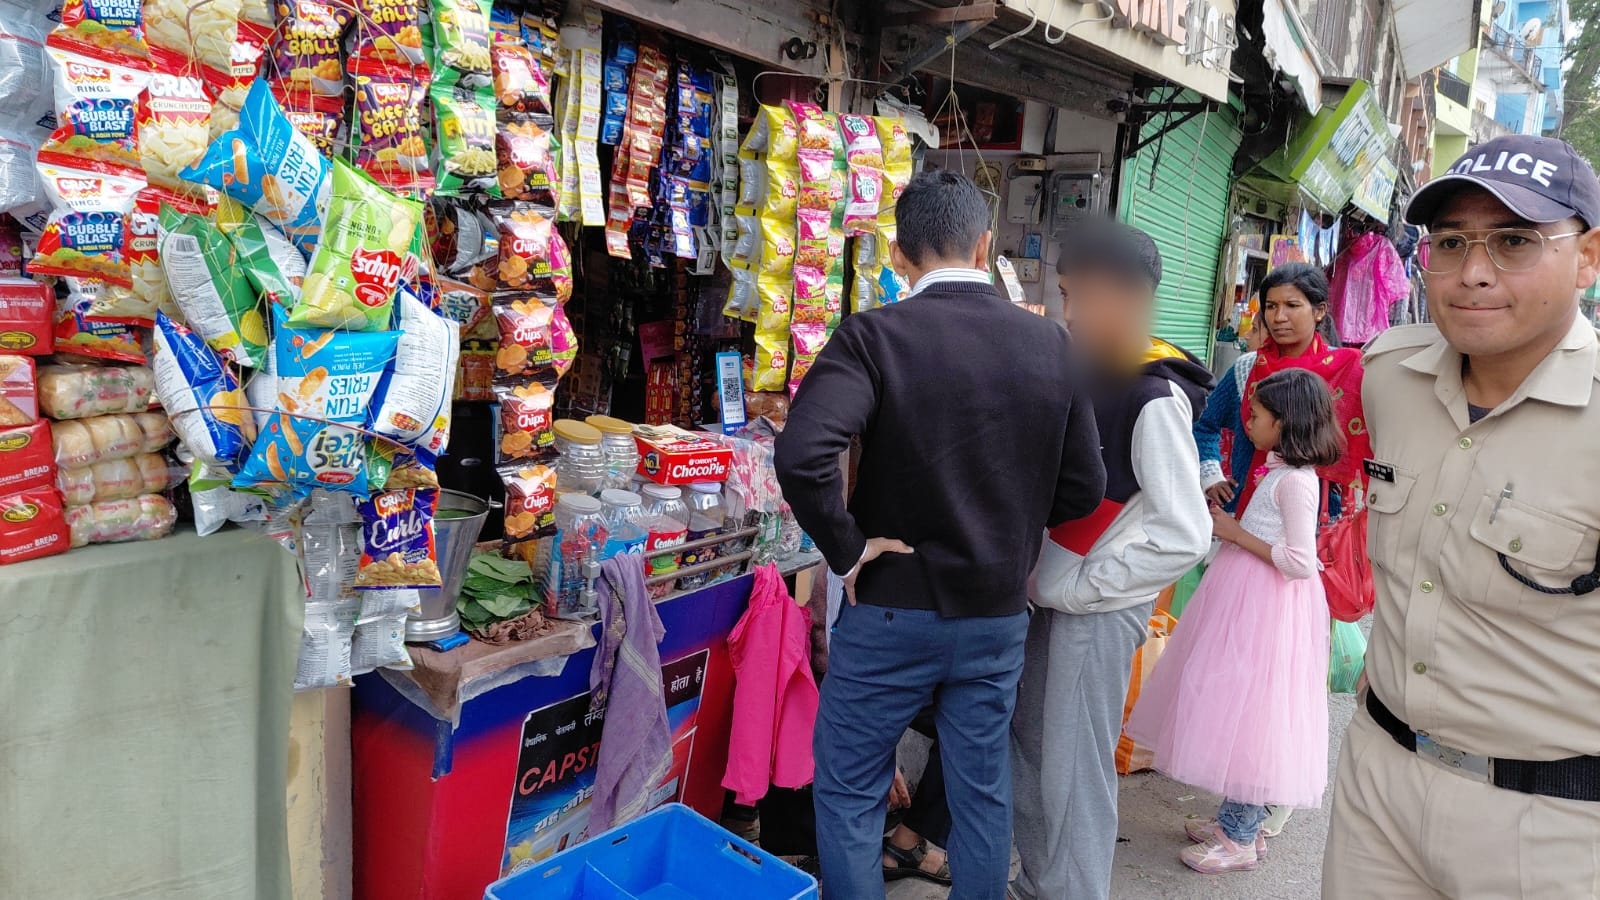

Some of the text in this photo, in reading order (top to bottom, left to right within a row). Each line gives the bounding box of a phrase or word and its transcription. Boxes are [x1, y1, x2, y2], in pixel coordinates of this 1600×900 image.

[100, 6, 138, 19] BLAST
[371, 5, 418, 24] BALLS
[289, 39, 339, 55] BALLS
[70, 63, 107, 77] CRAX
[77, 85, 111, 93] RINGS
[148, 73, 210, 102] CRAX
[376, 84, 405, 97] CRAX
[79, 110, 130, 121] BUBBLE
[290, 113, 320, 125] CRAX
[89, 121, 128, 132] BLAST
[280, 140, 306, 185] FRIES
[60, 179, 98, 190] CRAX
[294, 162, 318, 198] FUN
[67, 223, 119, 236] BUBBLE
[76, 233, 115, 245] BLAST
[512, 239, 542, 254] Chips
[353, 254, 400, 288] Chips
[513, 327, 542, 343] Chips
[328, 376, 371, 396] FRIES
[325, 396, 360, 417] FUN
[517, 414, 545, 428] Chips
[24, 465, 49, 477] BREAD
[672, 463, 725, 479] ChocoPie
[379, 490, 409, 508] CRAX
[523, 495, 549, 509] Chips
[371, 510, 423, 549] Curls
[34, 533, 58, 547] BREAD
[518, 741, 600, 796] CAPST
